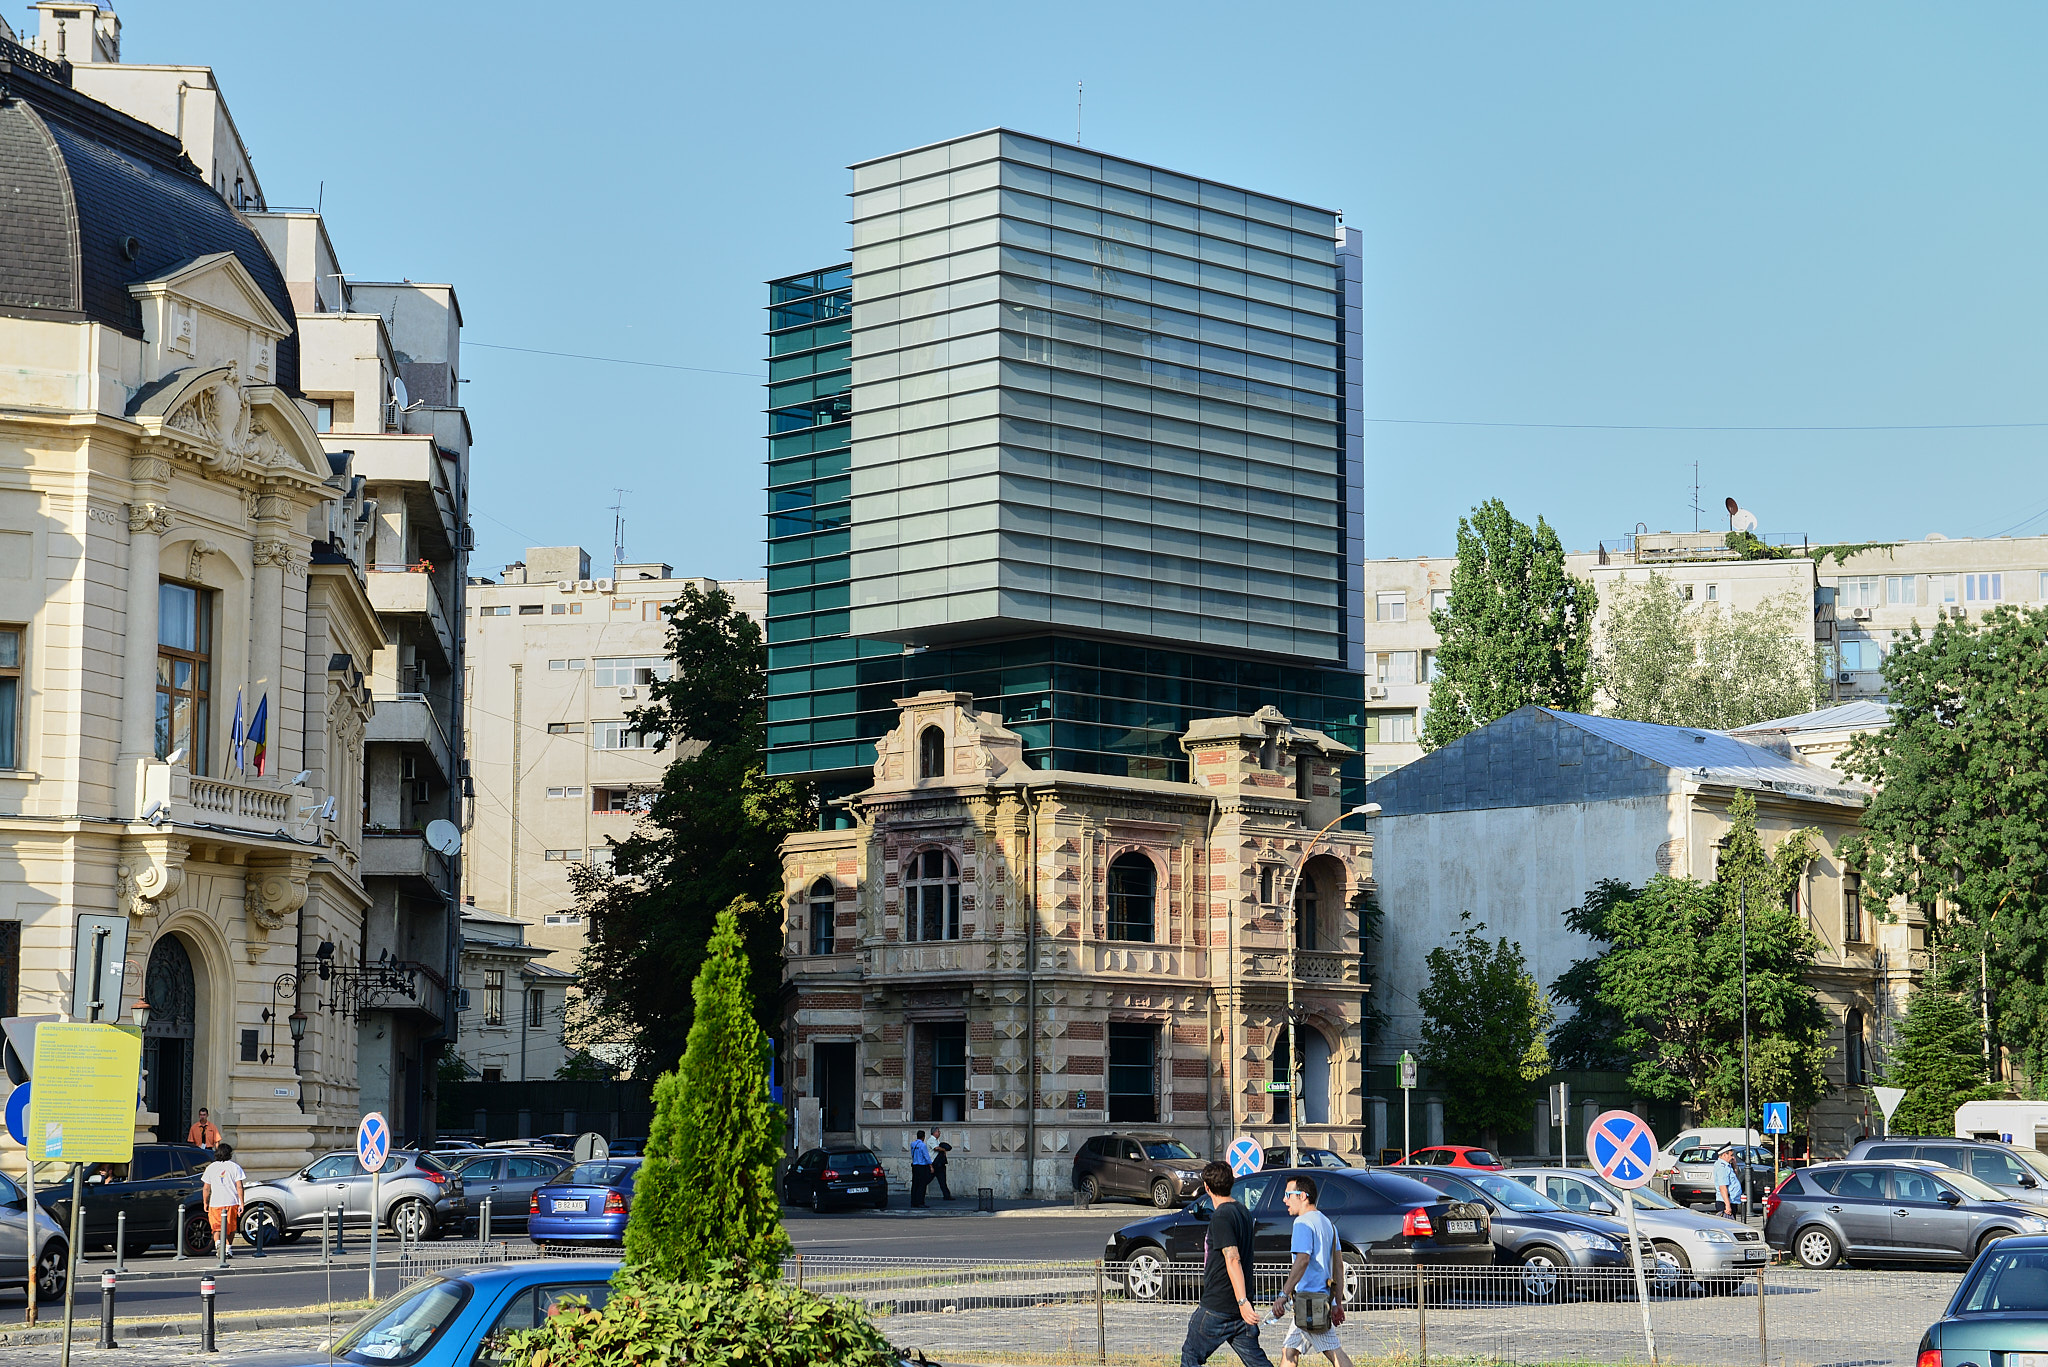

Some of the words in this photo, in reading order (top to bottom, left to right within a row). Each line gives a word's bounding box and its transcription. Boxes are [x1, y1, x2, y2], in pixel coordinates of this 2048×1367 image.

[557, 1201, 562, 1209] B
[564, 1201, 570, 1209] 82
[1450, 1221, 1456, 1230] B
